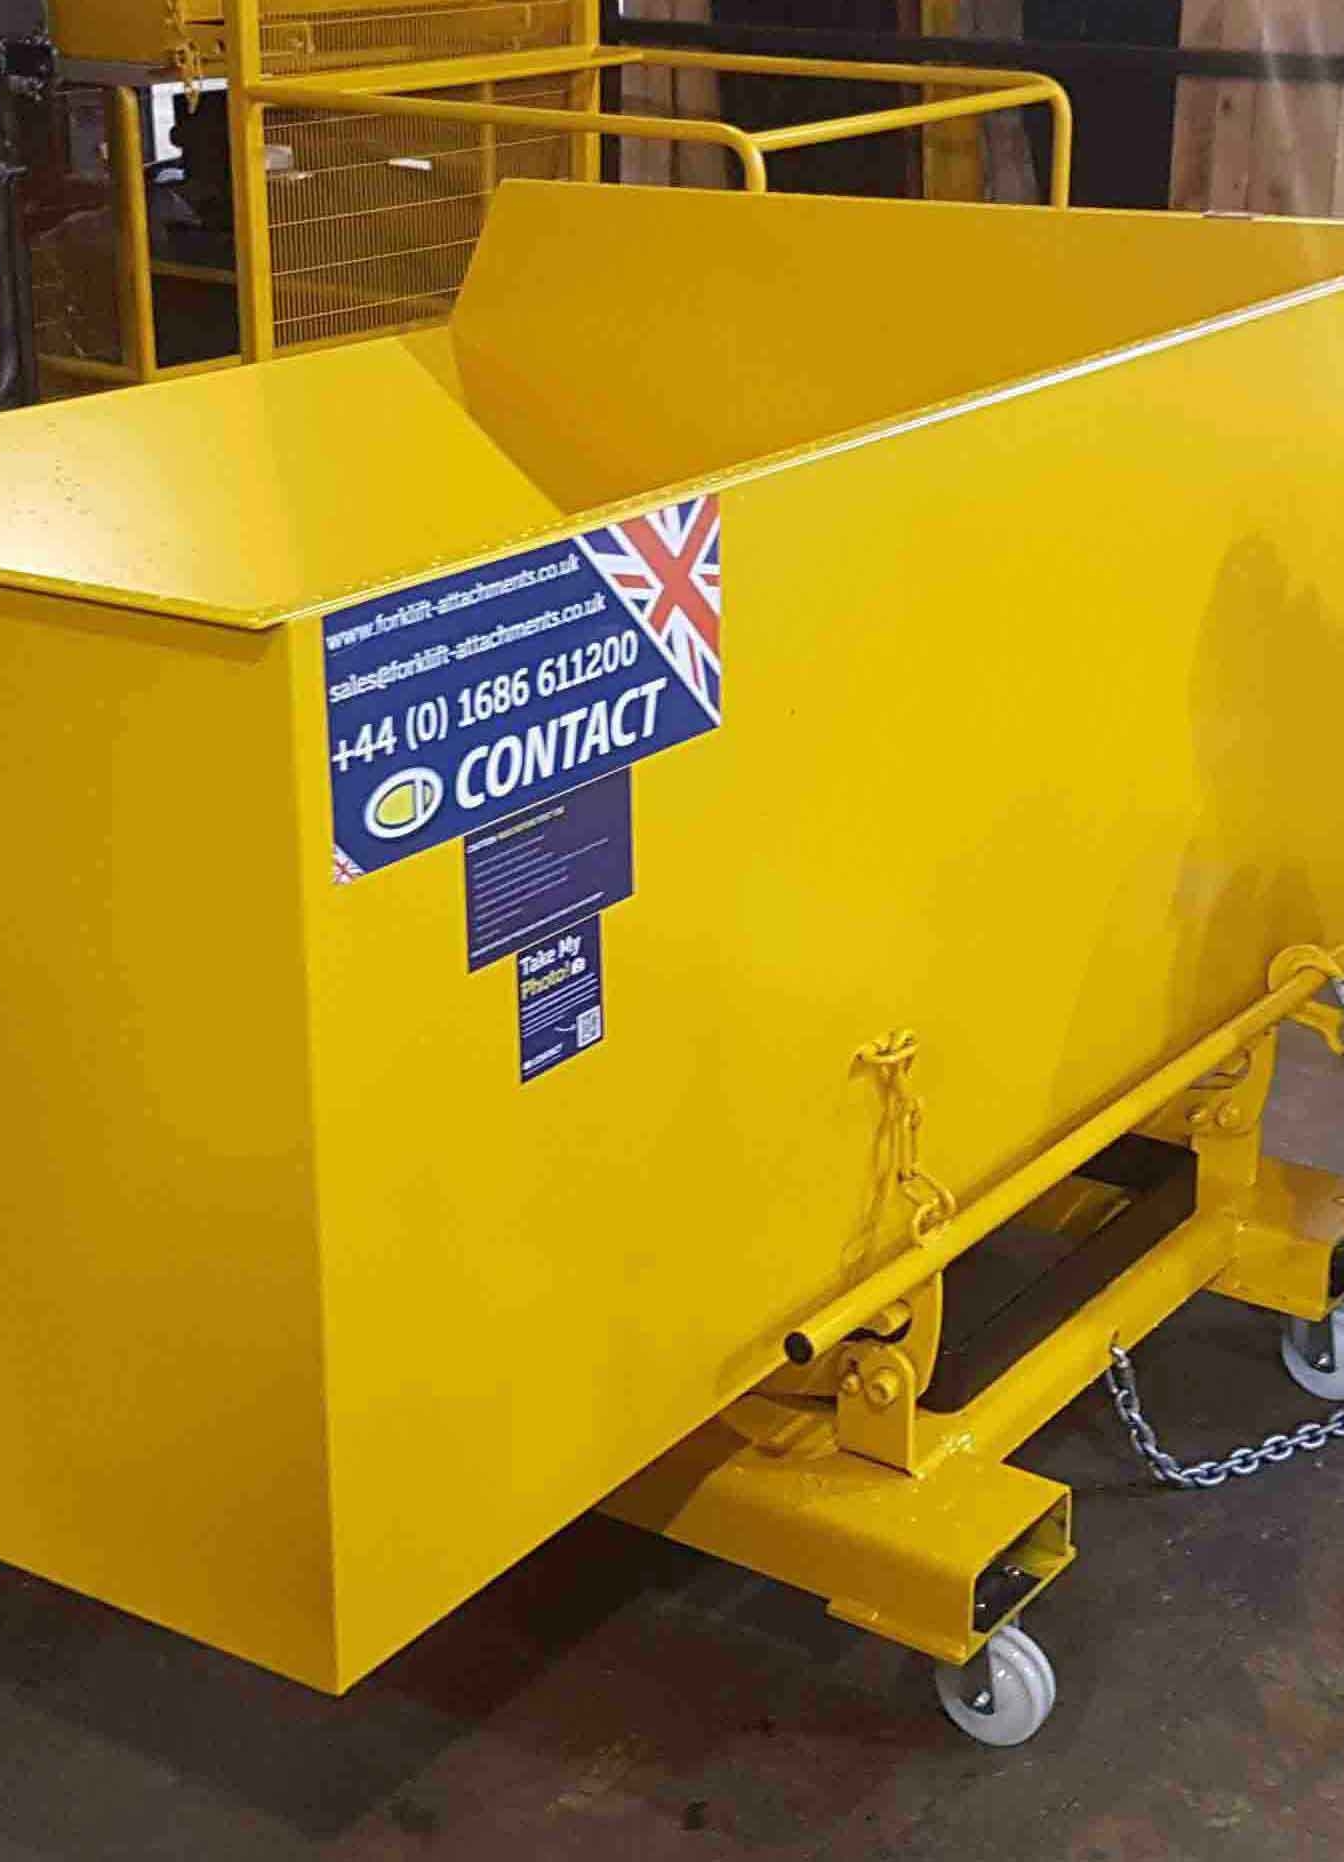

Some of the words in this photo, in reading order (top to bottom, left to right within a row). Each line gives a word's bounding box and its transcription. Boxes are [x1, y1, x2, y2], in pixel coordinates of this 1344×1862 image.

[325, 553, 582, 651] www.forklift-attachments.co.uk
[329, 591, 607, 703] sales@forklift-attachments.co.uk
[332, 716, 397, 772] +44
[405, 694, 449, 751] (0)
[458, 668, 529, 728] 1686
[537, 629, 639, 694] 611200
[455, 676, 667, 811] CONTACT
[520, 948, 557, 976] Take
[557, 935, 583, 959] My
